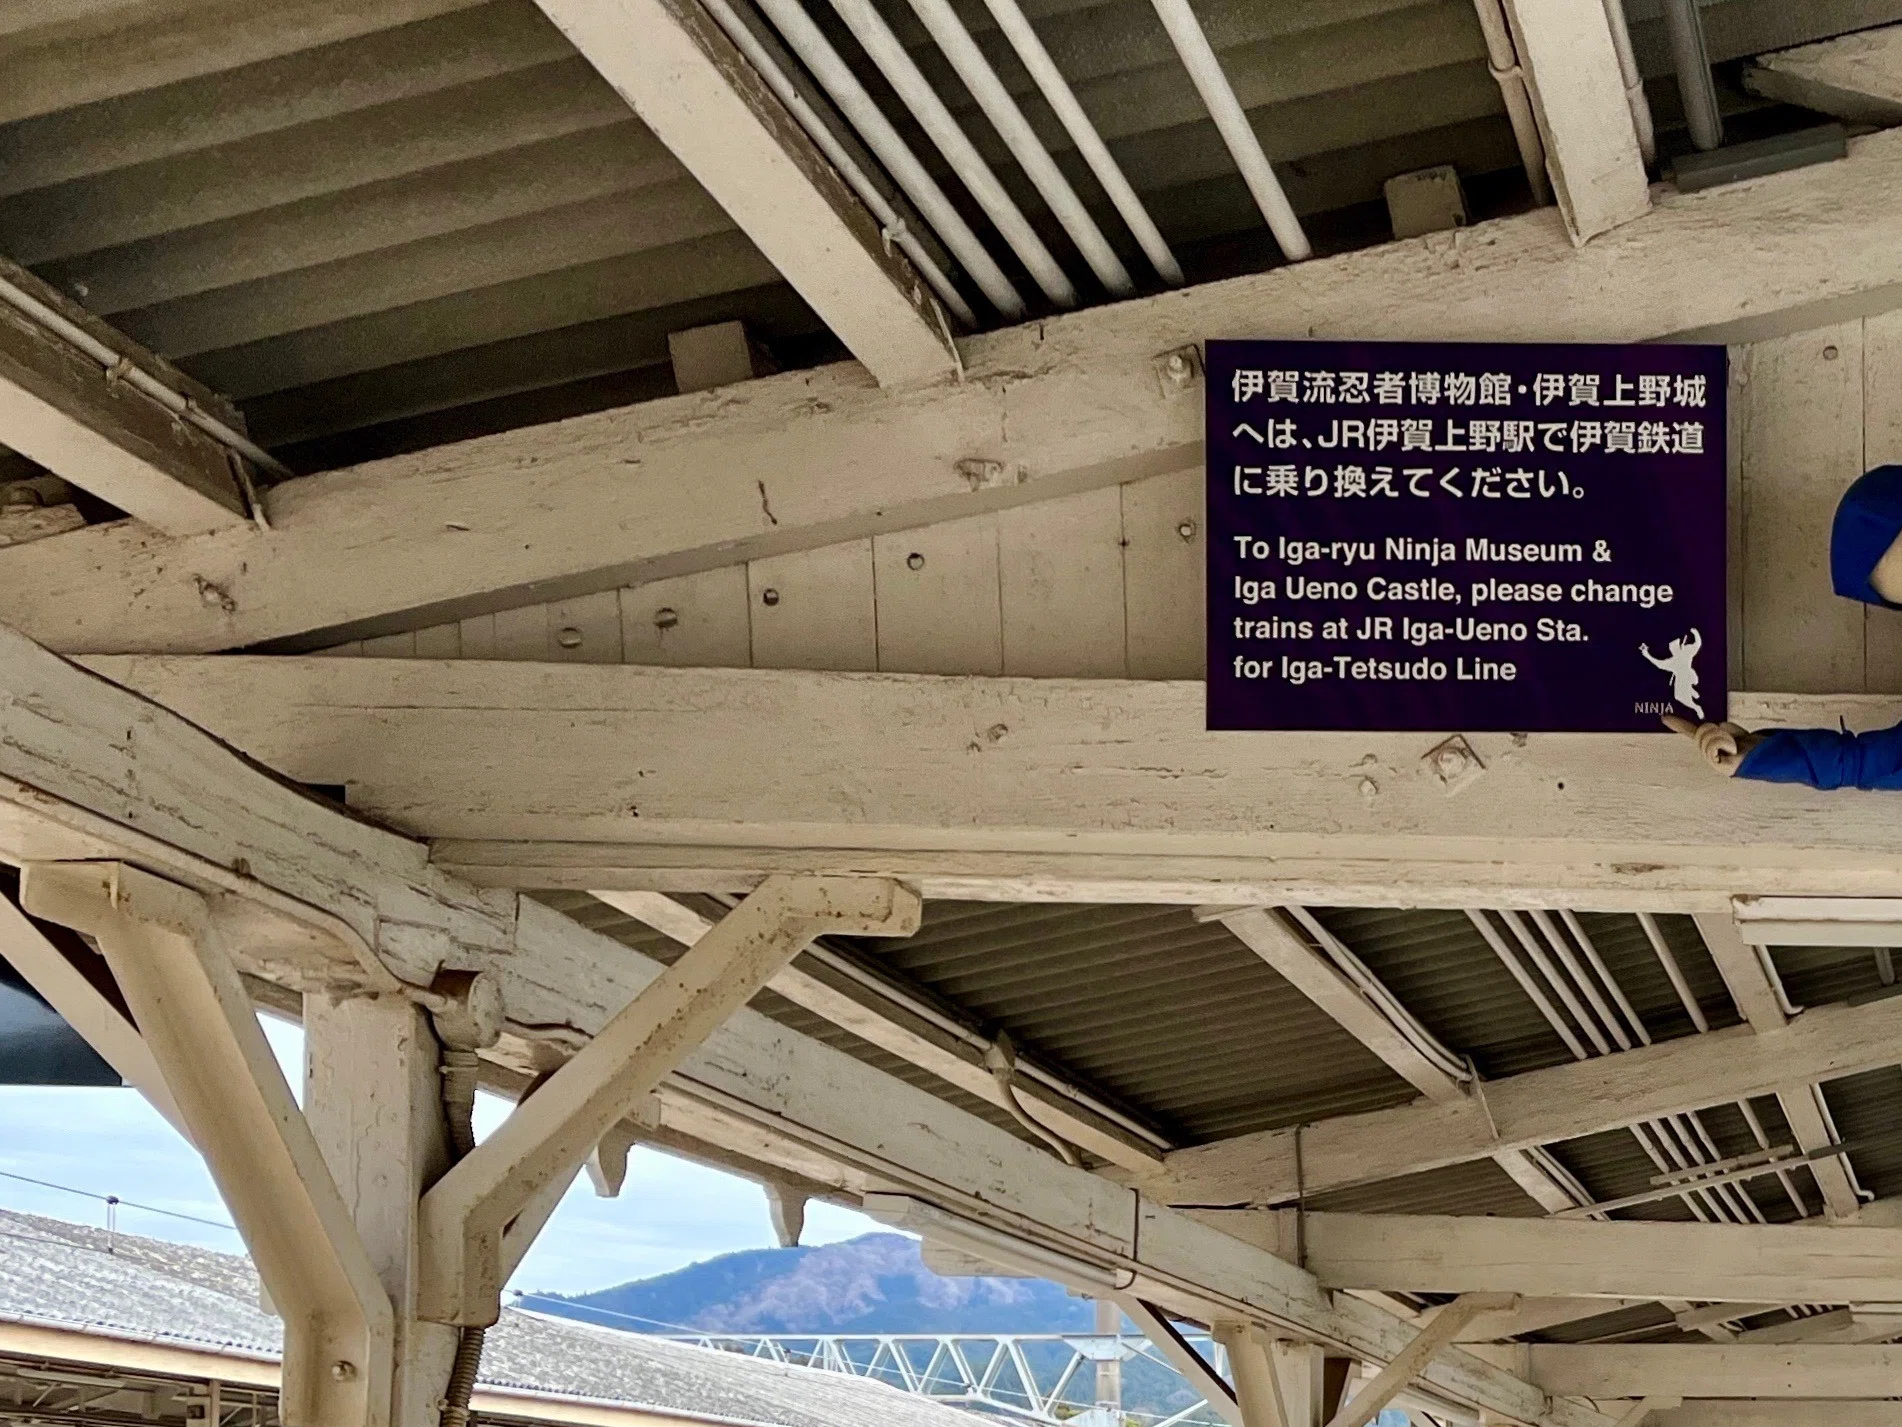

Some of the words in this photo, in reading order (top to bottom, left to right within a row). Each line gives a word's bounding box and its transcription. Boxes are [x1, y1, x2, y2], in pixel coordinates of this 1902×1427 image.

[1232, 369, 1706, 408] 伊賀流忍者博物館・伊賀上野城
[1232, 418, 1705, 454] へは、JR伊賀上野駅で伊賀鉄道
[1234, 464, 1585, 499] に乗り換えてください。
[1234, 536, 1269, 560] To
[1279, 536, 1375, 566] Iga-ryu
[1385, 537, 1456, 567] Ninja
[1465, 538, 1583, 562] Museum
[1592, 539, 1612, 563] &
[1234, 575, 1276, 605] Iga
[1286, 576, 1358, 600] Ueno
[1366, 576, 1462, 605] Castle,
[1471, 577, 1563, 607] please
[1570, 578, 1674, 609] change
[1233, 616, 1314, 639] trains
[1322, 617, 1349, 640] at
[1356, 616, 1393, 640] JR
[1403, 617, 1528, 645] Iga-Ueno
[1536, 617, 1589, 642] Sta.
[1233, 655, 1273, 679] for
[1281, 655, 1447, 685] Iga-Tetsudo
[1456, 657, 1517, 681] Line
[1634, 701, 1674, 714] NINJA
